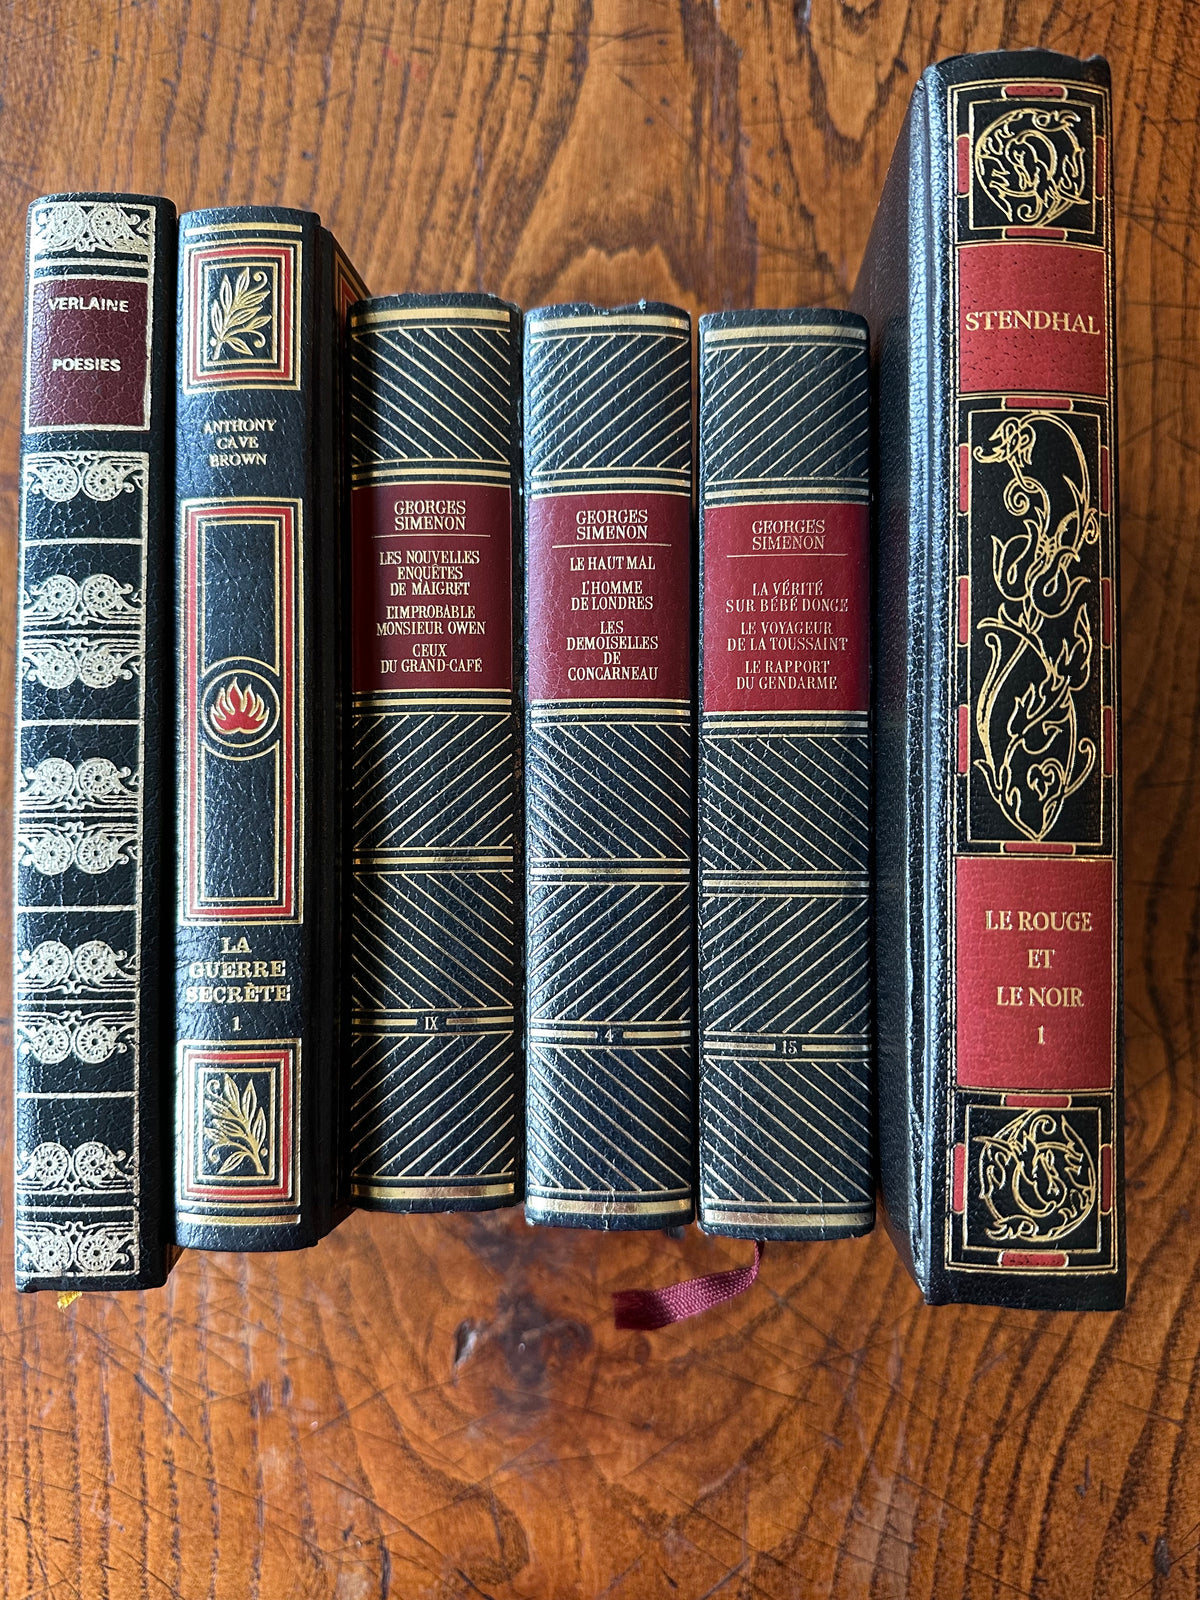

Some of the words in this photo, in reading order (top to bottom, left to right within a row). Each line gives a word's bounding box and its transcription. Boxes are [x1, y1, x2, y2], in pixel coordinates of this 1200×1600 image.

[49, 297, 129, 313] VERLAINE
[965, 310, 1101, 336] STENDHAL
[52, 358, 121, 372] POESIES
[204, 418, 277, 434] ANTHONY
[216, 436, 259, 450] CAVE
[210, 453, 267, 467] BROWN
[394, 500, 466, 515] GEORGES
[394, 515, 466, 531] SIMENON
[576, 509, 648, 524] GEORGES
[576, 525, 648, 540] SIMENON
[752, 519, 825, 534] GEORGES
[752, 535, 825, 551] SIMENON
[379, 551, 402, 565] LES
[406, 550, 480, 564] NOUVELLES
[570, 557, 585, 571] LE
[588, 556, 625, 570] HAUT
[626, 556, 656, 570] MAL
[397, 564, 464, 582] ENQUÊTES
[390, 582, 406, 596] DE
[412, 582, 470, 596] MAIGRET
[582, 581, 643, 595] L'HOMME
[752, 582, 769, 596] LA
[772, 579, 823, 596] VÉRITÉ
[571, 597, 589, 610] DE
[592, 596, 653, 610] LONDRES
[725, 599, 756, 613] SUR
[760, 596, 798, 612] BÉBÉ
[802, 598, 848, 612] DONGE
[376, 622, 444, 636] MONSIEUR
[447, 621, 486, 635] OWEN
[600, 620, 624, 634] LES
[741, 622, 756, 635] LE
[761, 621, 833, 635] VOYAGEUR
[412, 643, 448, 657] CEUX
[566, 636, 659, 651] DEMOISELLES
[727, 638, 746, 652] DE
[750, 638, 766, 651] LA
[769, 637, 848, 651] TOUSSAINT
[380, 660, 397, 674] DU
[401, 658, 483, 673] GRAND-CAFÉ
[603, 652, 621, 665] DE
[567, 667, 659, 681] CONCARNEAU
[745, 660, 760, 674] LE
[765, 660, 830, 673] RAPPORT
[736, 677, 754, 690] DU
[758, 676, 837, 690] GENDARME
[985, 910, 1013, 931] LE
[1017, 911, 1093, 932] ROUGE
[221, 936, 252, 954] LA
[1028, 948, 1056, 969] ET
[189, 960, 286, 978] GUERRE
[996, 986, 1023, 1006] LE
[1028, 987, 1085, 1007] NOIR
[232, 1016, 242, 1032] 1
[424, 1016, 439, 1031] IX
[604, 1028, 614, 1042] 4
[1037, 1025, 1046, 1045] 1
[782, 1040, 798, 1054] 15
